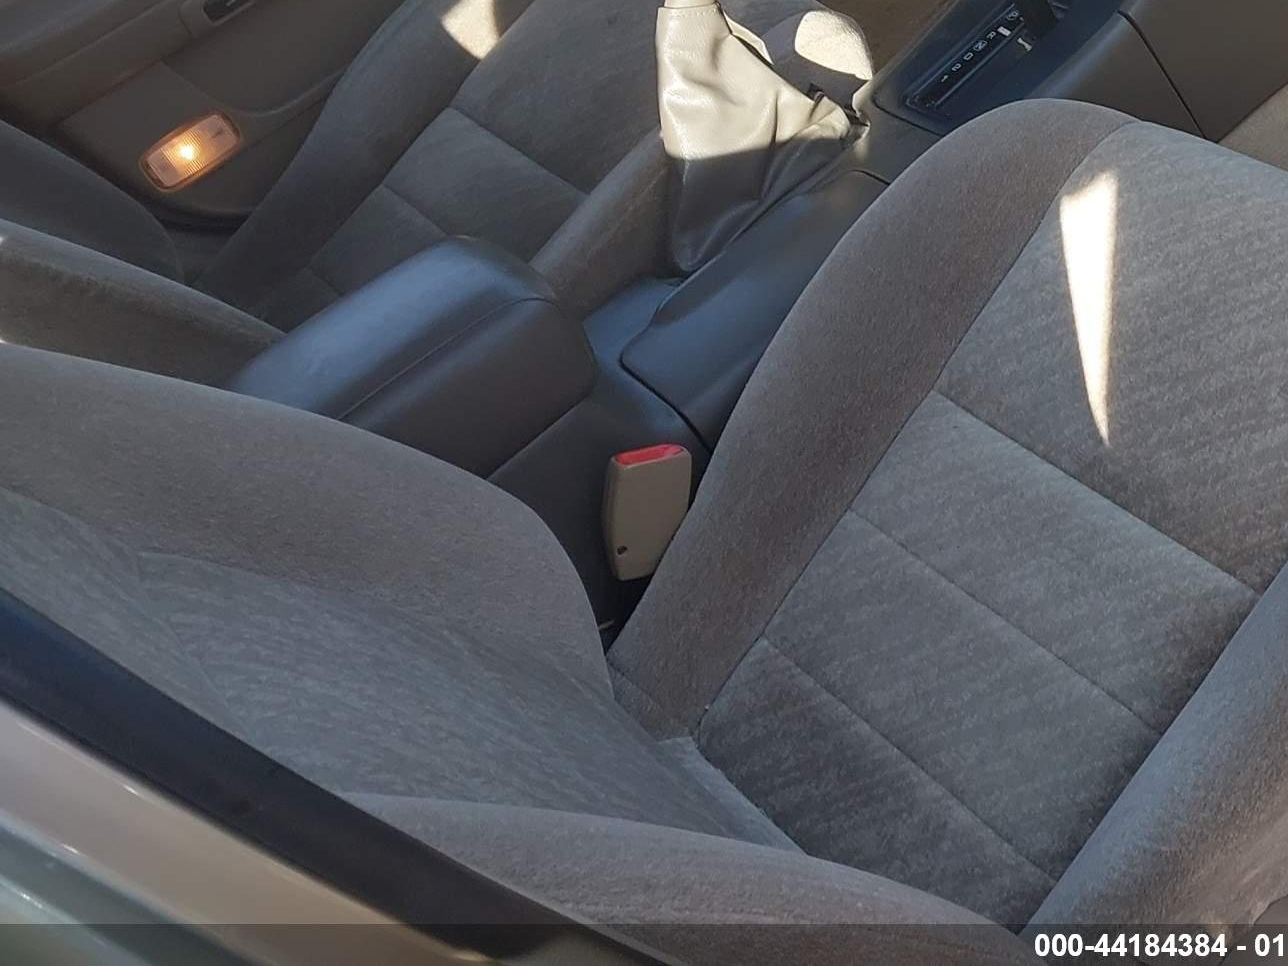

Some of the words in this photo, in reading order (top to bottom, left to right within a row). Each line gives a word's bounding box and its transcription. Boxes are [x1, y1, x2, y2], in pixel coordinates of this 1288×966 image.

[986, 31, 997, 40] R
[974, 40, 987, 51] N
[963, 52, 974, 61] D
[951, 63, 962, 72] 2
